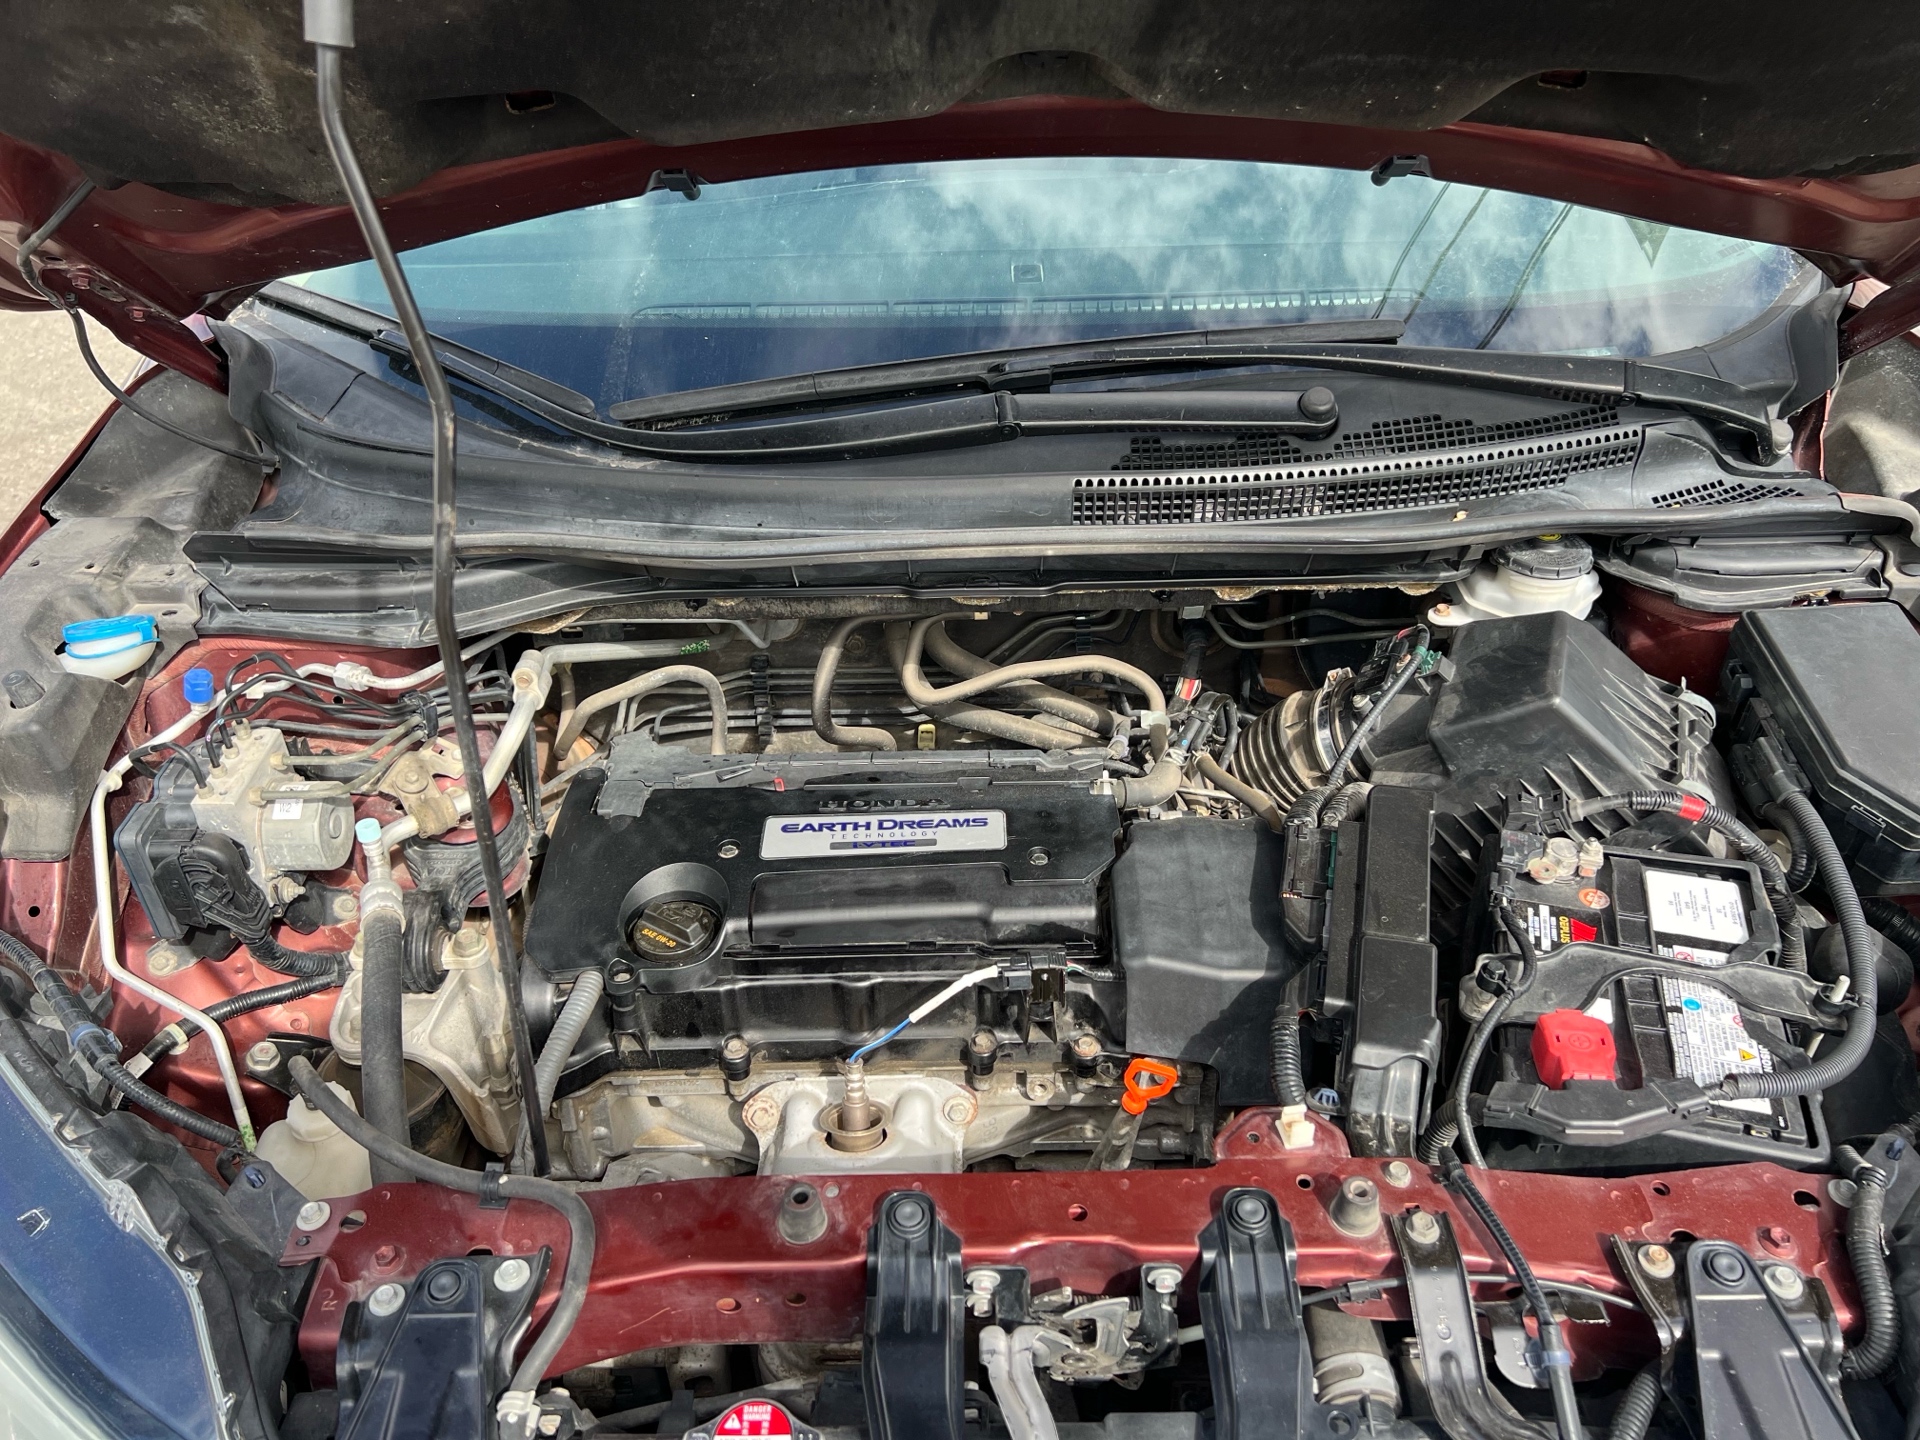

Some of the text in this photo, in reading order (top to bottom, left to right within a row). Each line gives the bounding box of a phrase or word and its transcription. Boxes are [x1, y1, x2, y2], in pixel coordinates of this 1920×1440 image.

[819, 798, 950, 812] HONDA
[780, 817, 989, 834] EARTH DREAMS
[831, 831, 938, 840] TECHNOLOGY
[641, 928, 657, 939] SAE
[743, 1404, 772, 1413] DANGER
